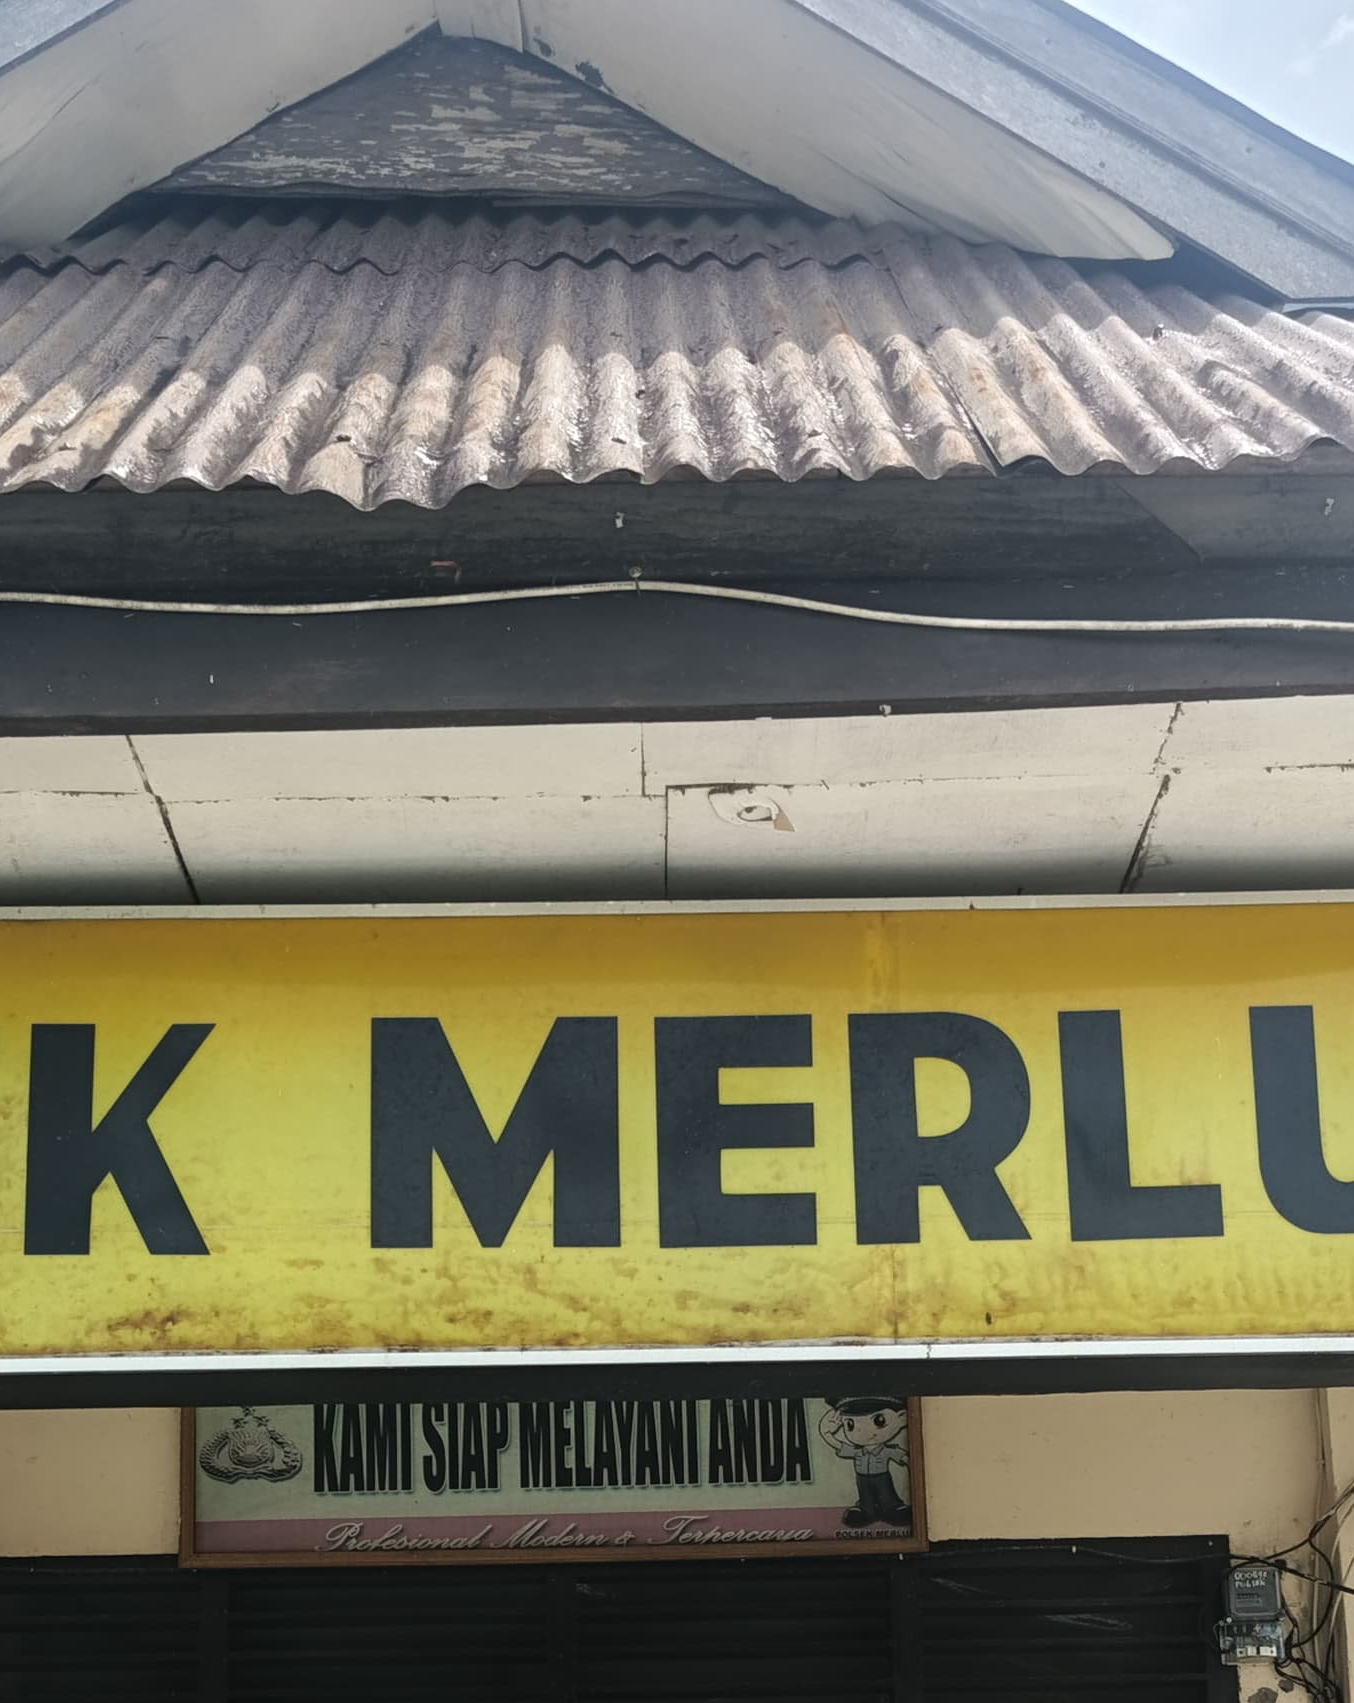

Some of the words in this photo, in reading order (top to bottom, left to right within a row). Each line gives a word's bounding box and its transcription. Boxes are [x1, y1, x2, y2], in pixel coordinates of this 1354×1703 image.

[313, 1403, 413, 1492] KAMI
[422, 1402, 510, 1494] SIAP
[518, 1400, 698, 1490] MELAYANI
[708, 1398, 812, 1485] ANDA
[315, 1522, 493, 1550] Profesional
[490, 1518, 609, 1548] Modern
